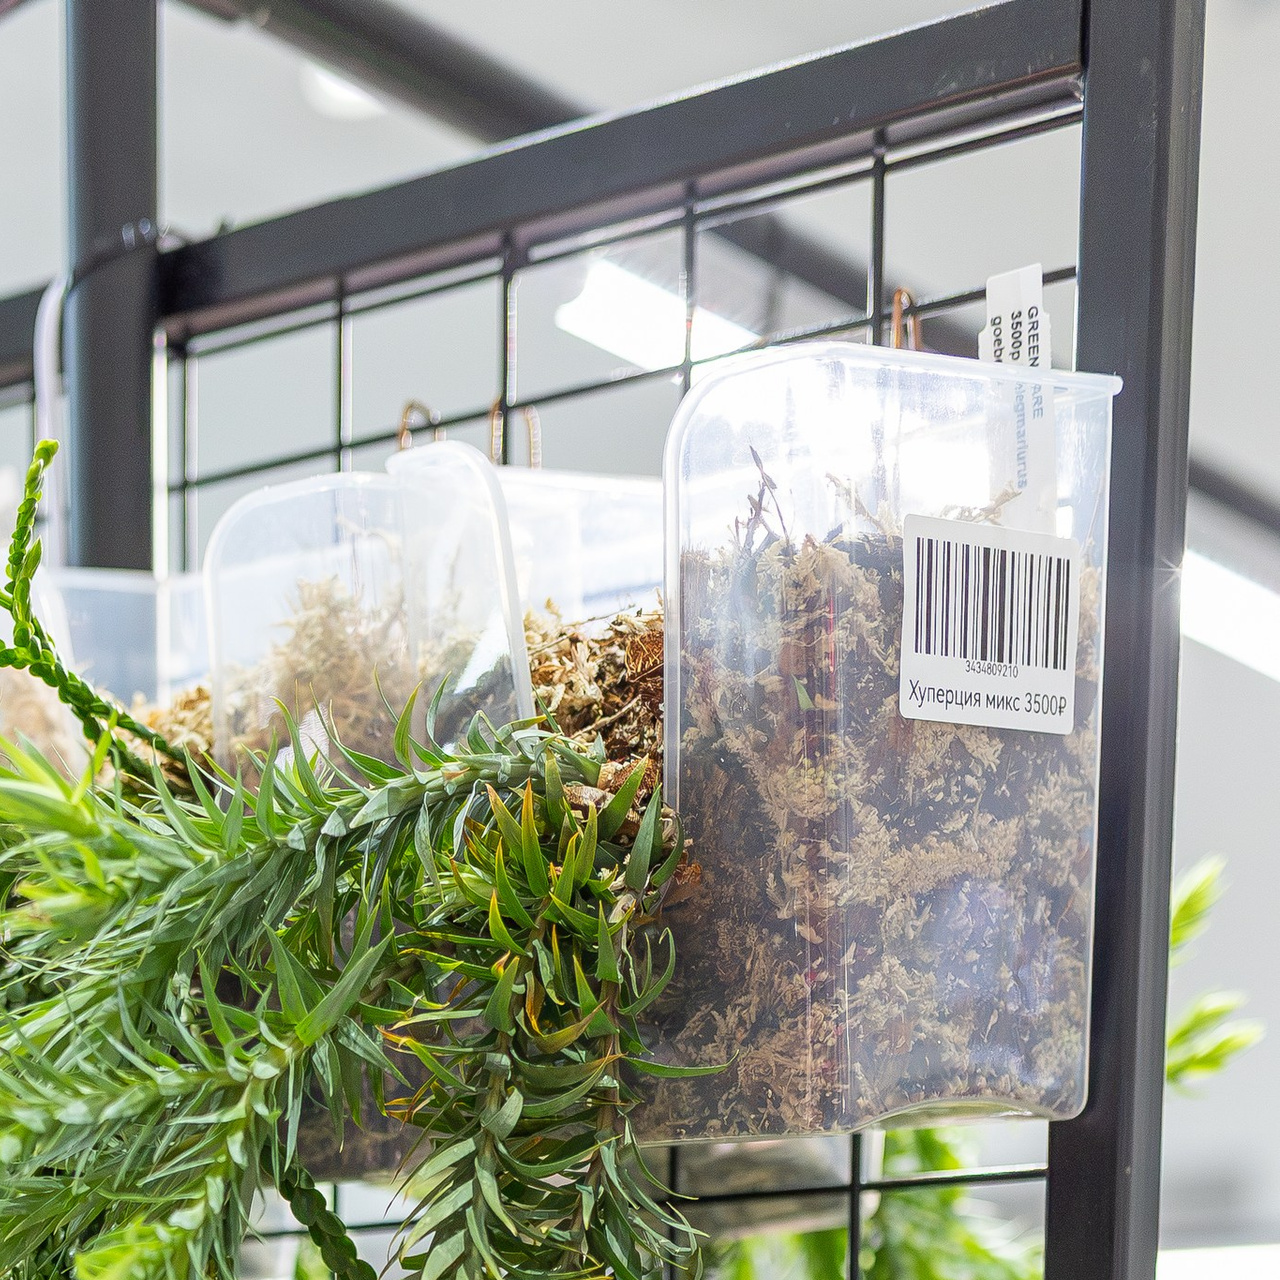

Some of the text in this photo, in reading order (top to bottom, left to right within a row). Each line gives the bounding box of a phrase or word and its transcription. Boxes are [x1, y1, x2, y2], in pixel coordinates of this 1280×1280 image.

[965, 660, 1019, 678] 3434809210
[909, 679, 1067, 716] Хуперция микс 3500₽
